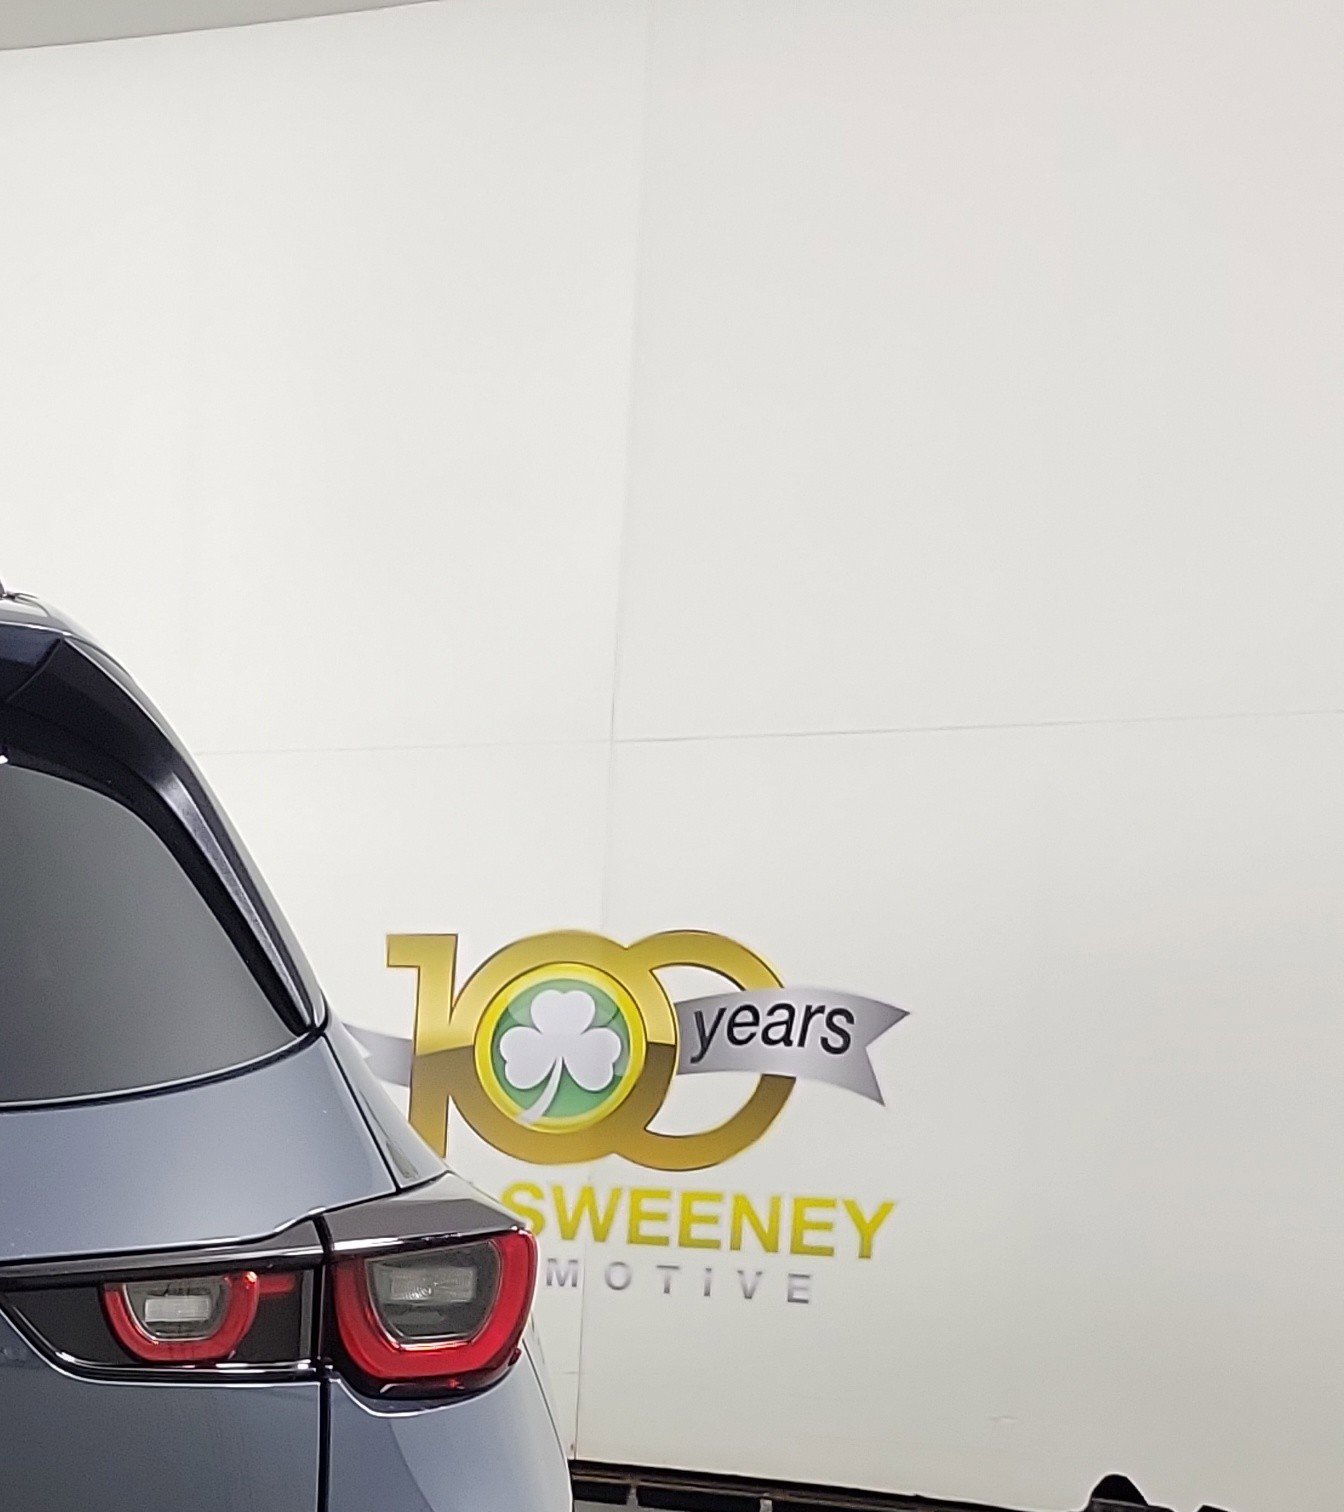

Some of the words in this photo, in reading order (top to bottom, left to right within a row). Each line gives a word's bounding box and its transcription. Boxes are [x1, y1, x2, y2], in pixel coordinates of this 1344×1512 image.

[386, 929, 797, 1172] 100
[690, 1002, 856, 1065] years
[501, 1180, 895, 1260] SWEENEY
[545, 1257, 812, 1305] MOTIVE
